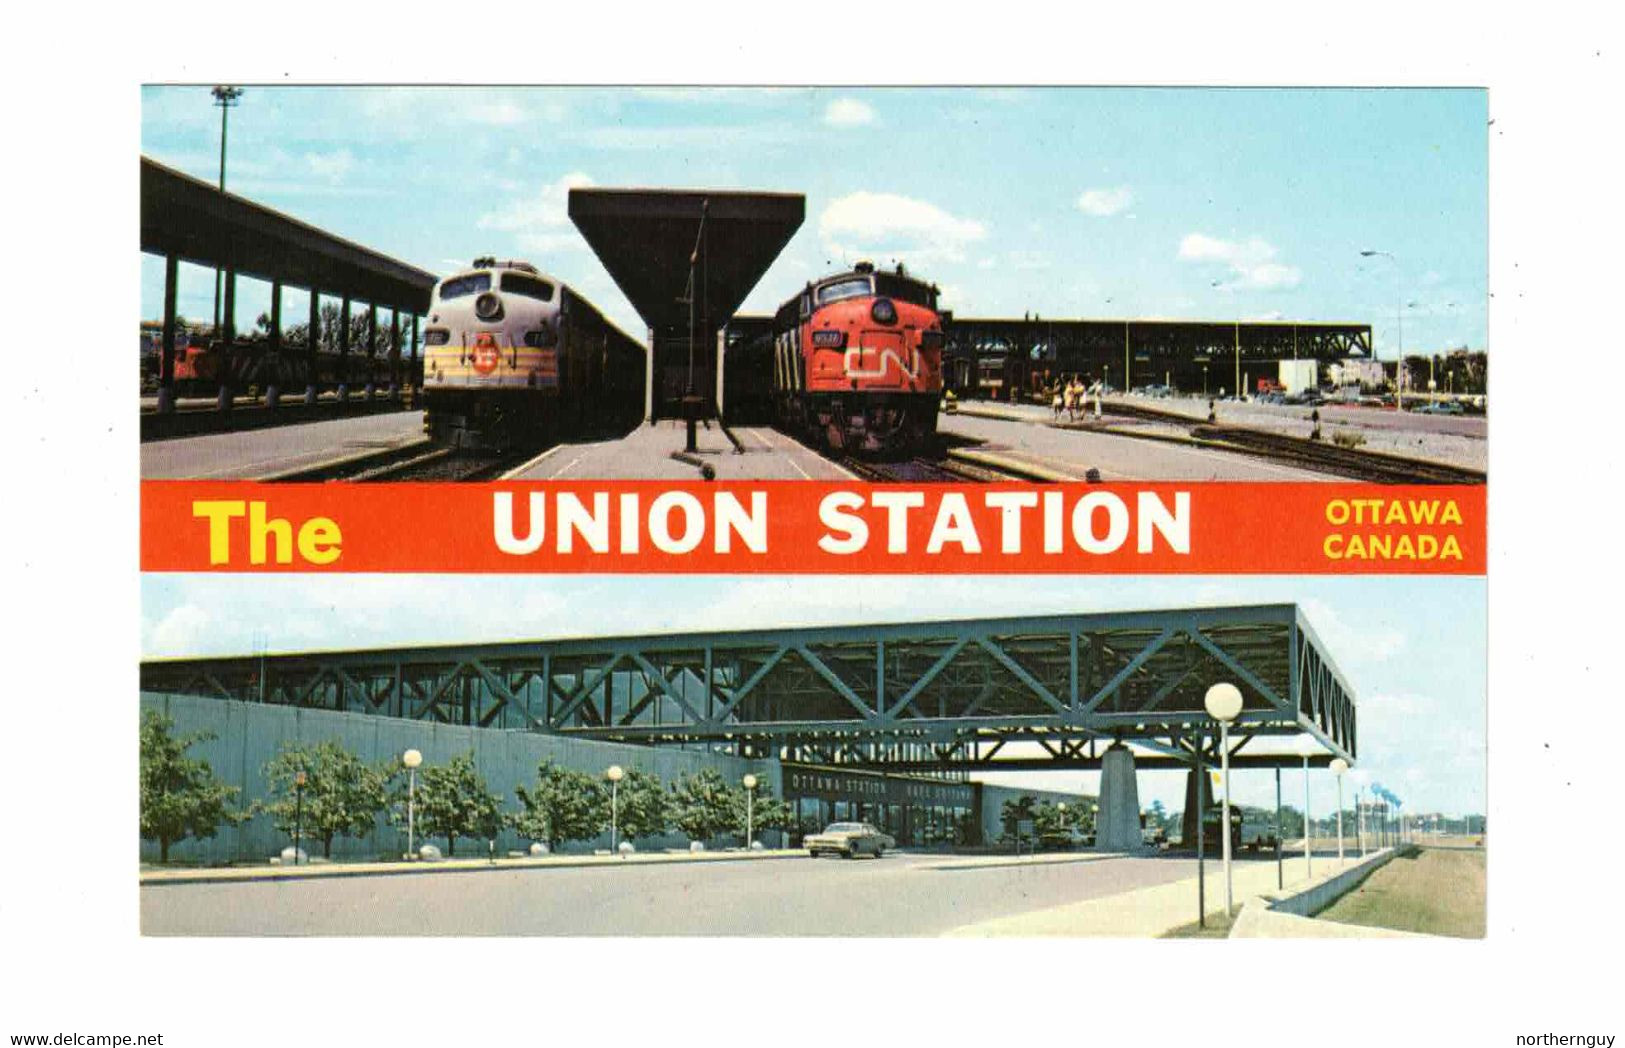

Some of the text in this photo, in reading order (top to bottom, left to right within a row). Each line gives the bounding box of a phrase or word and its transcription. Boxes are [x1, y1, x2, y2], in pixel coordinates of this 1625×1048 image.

[844, 347, 919, 379] CN
[1325, 499, 1463, 525] OTTAWA
[193, 490, 1191, 565] The UNION STATION
[1323, 534, 1463, 560] CANADA
[792, 774, 886, 794] OTTAWA STATION
